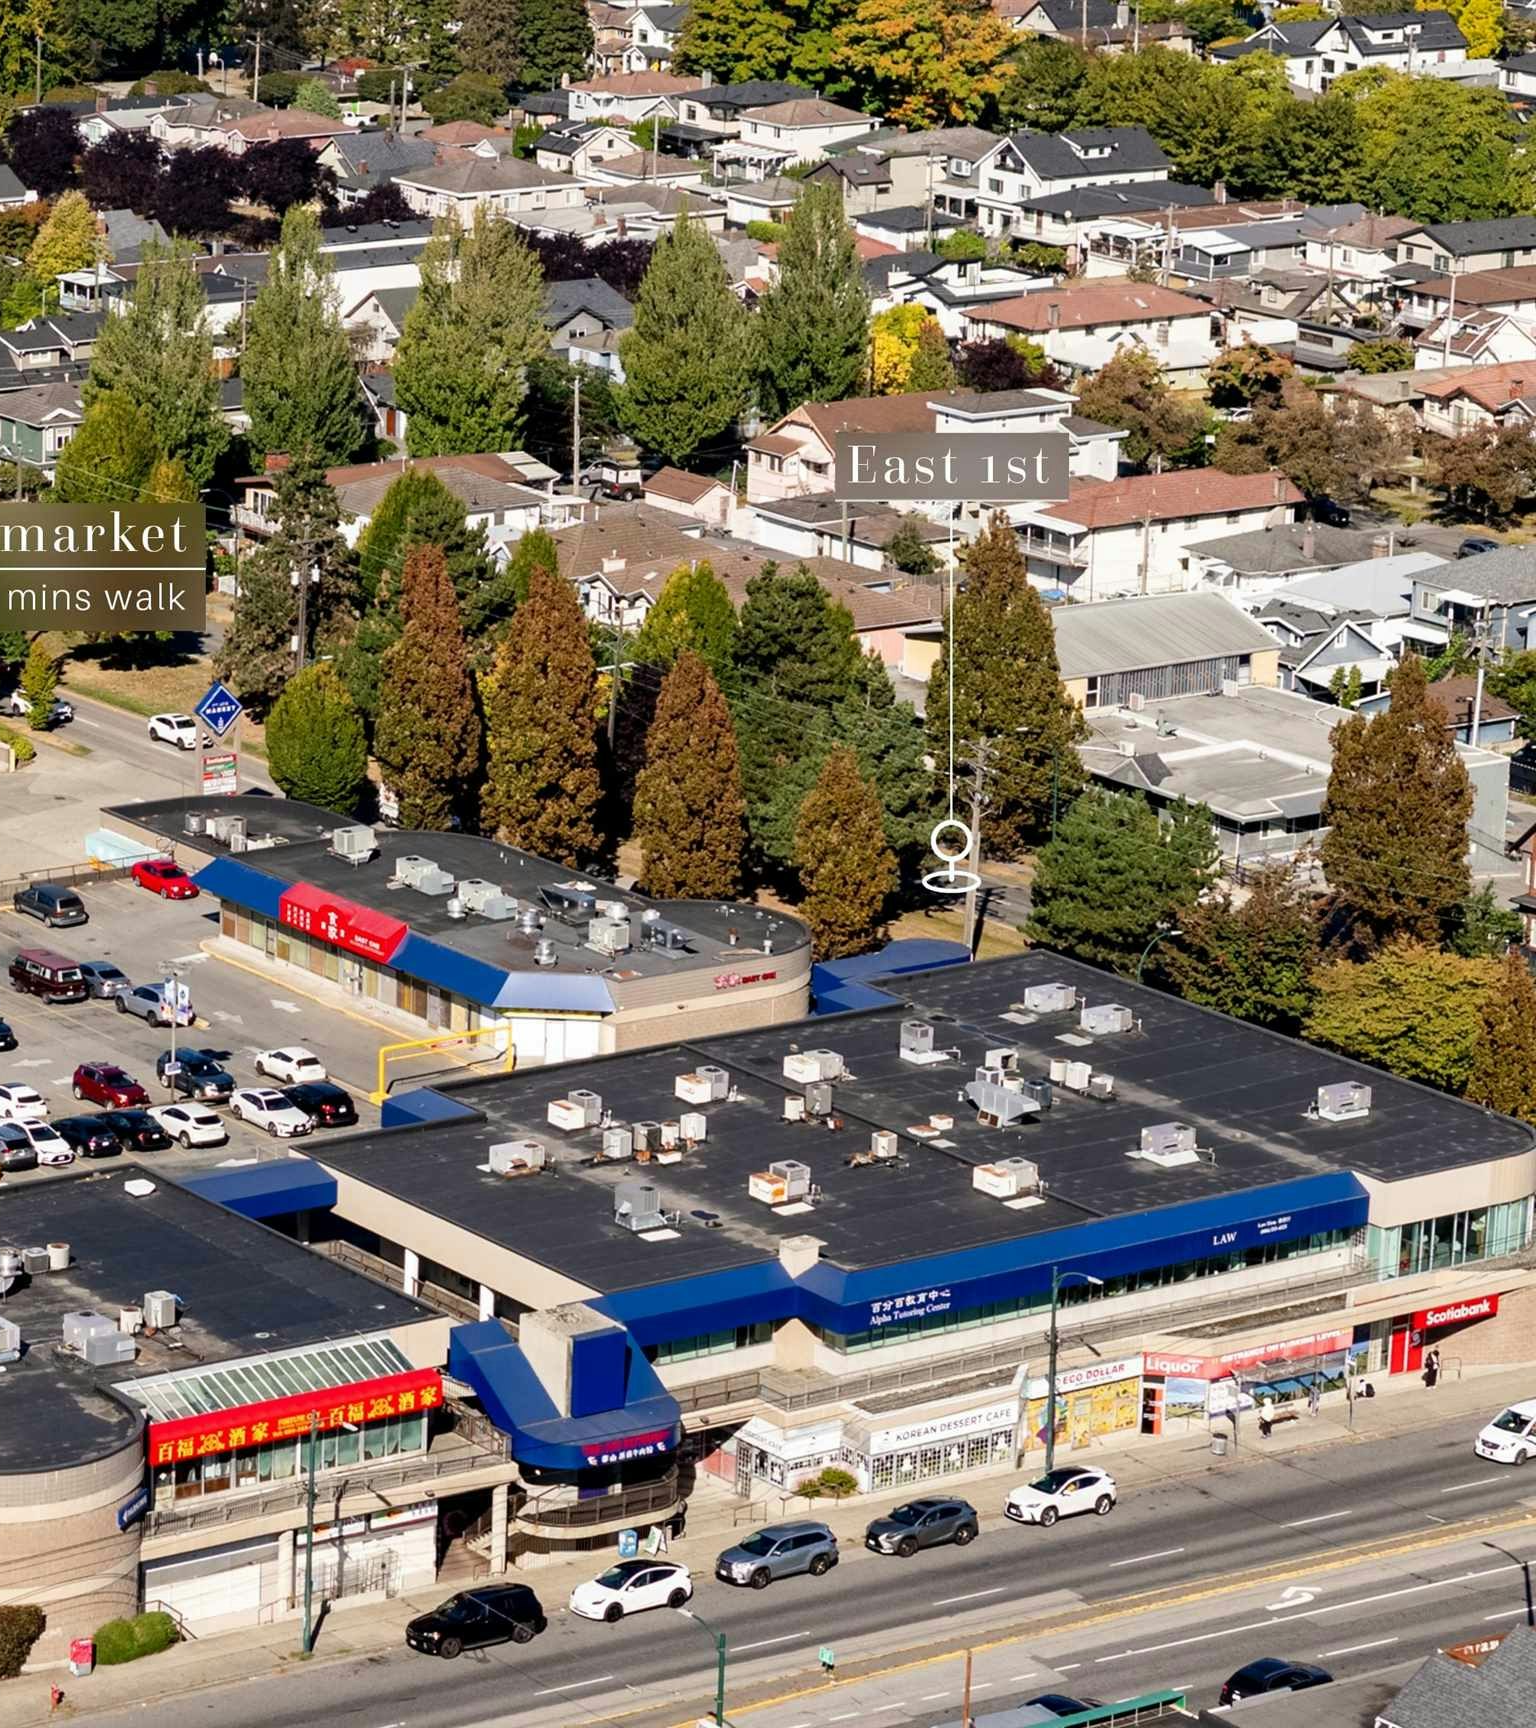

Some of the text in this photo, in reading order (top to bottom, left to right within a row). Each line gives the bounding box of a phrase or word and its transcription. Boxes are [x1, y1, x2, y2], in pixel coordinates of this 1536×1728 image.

[1212, 1231, 1238, 1246] LAW
[870, 1314, 893, 1326] Alpha
[1426, 1299, 1491, 1326] Scotiabank
[1062, 1373, 1084, 1384] ECO
[1086, 1363, 1126, 1381] DOLLAR
[1146, 1356, 1201, 1374] Liquor
[895, 1408, 1012, 1442] KOREAN DESSERT CAFE
